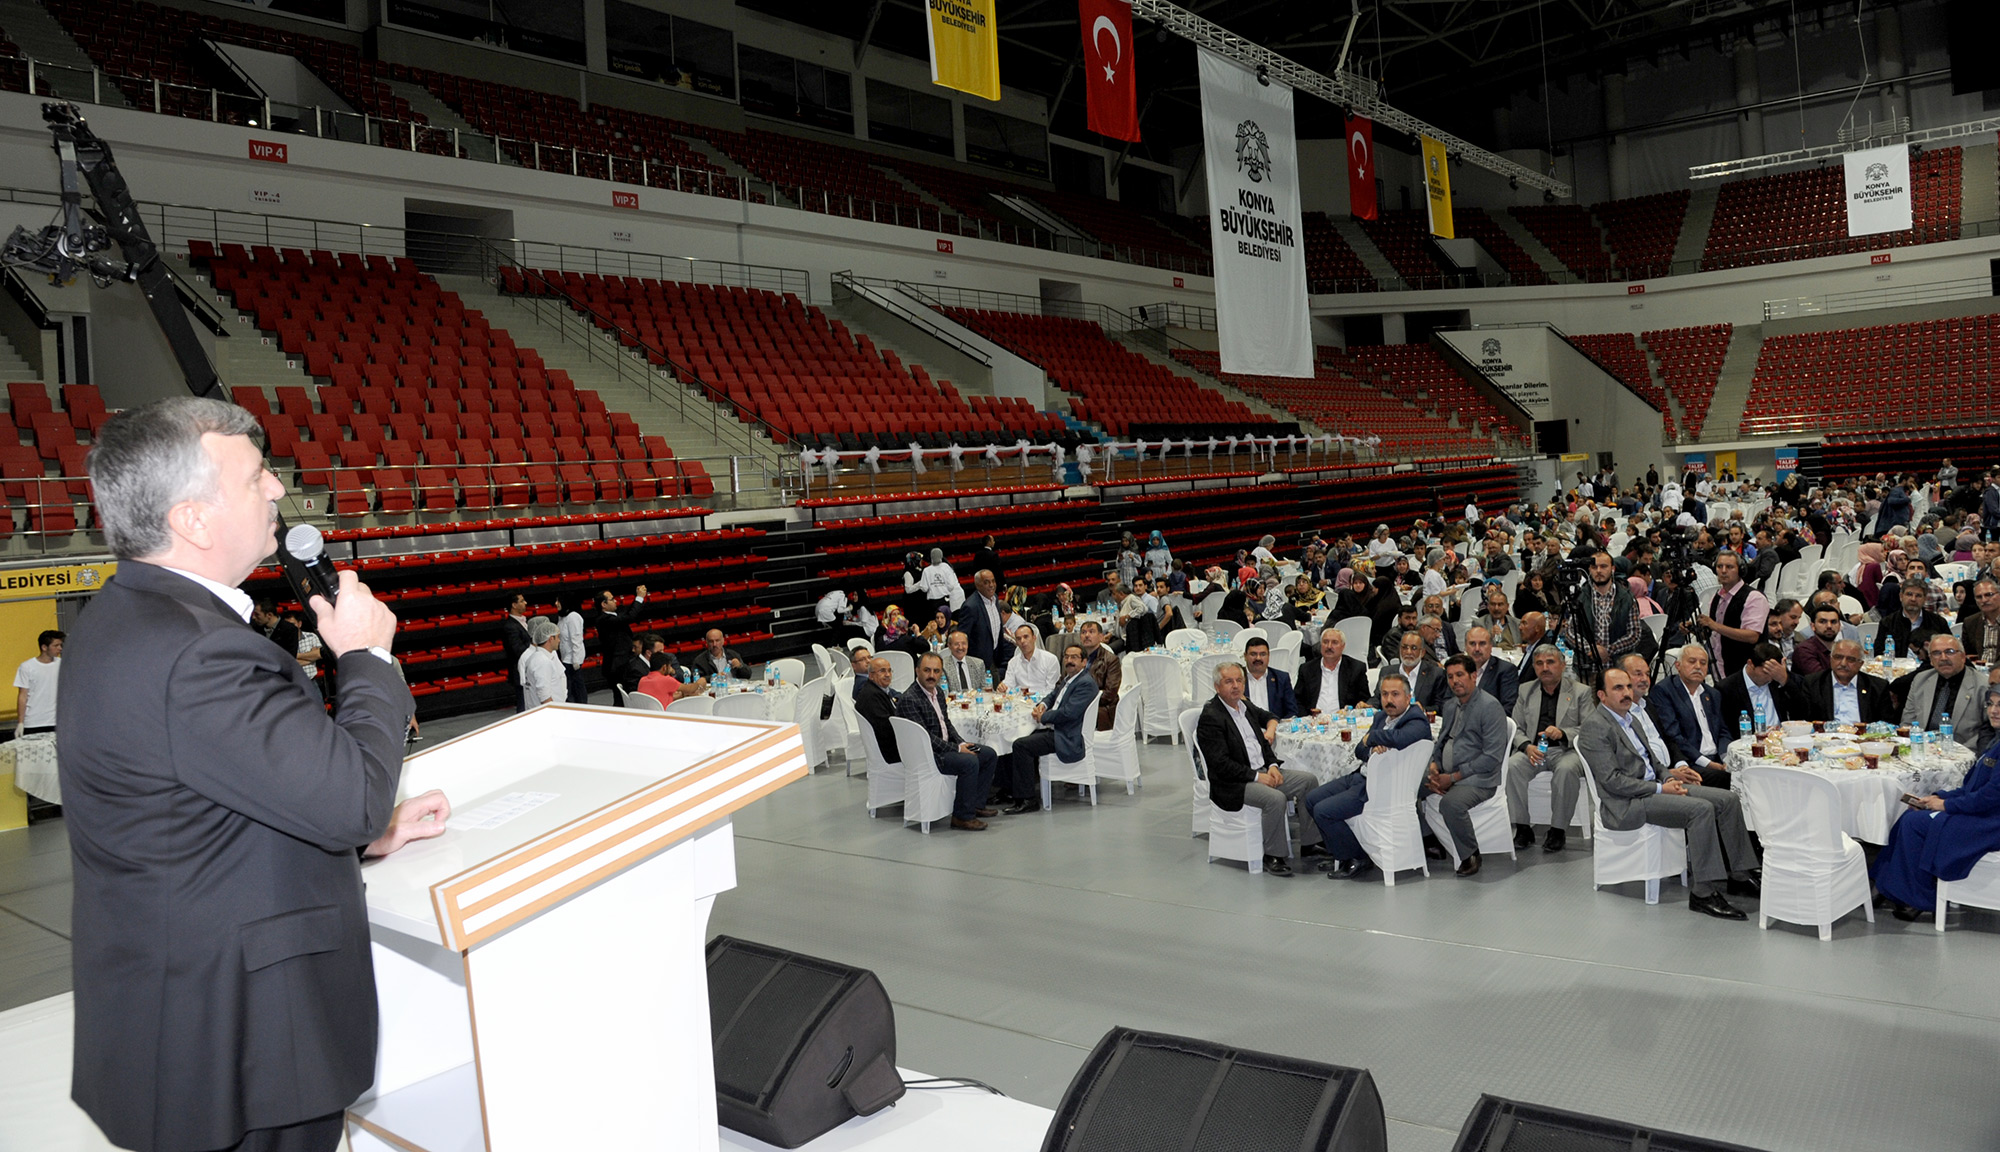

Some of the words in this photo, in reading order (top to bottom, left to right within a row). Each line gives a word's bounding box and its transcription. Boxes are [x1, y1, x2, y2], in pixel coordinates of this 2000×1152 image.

[941, 15, 976, 34] BELEDİYESİ
[252, 144, 273, 157] VIP
[275, 147, 284, 159] 4
[1853, 186, 1903, 200] BÜYÜKŞEHİR
[1865, 182, 1890, 190] KONYA
[614, 194, 629, 205] VIP
[630, 196, 637, 206] 2
[1238, 188, 1275, 215] KONYA
[1220, 206, 1295, 248] BÜYÜKŞEHİR
[938, 242, 948, 250] VIP
[1238, 241, 1282, 263] BELEDİYESİ
[1477, 363, 1513, 372] ÜYÜKŞEHİR
[306, 500, 312, 509] A
[0, 570, 71, 590] LEDİYESİ
